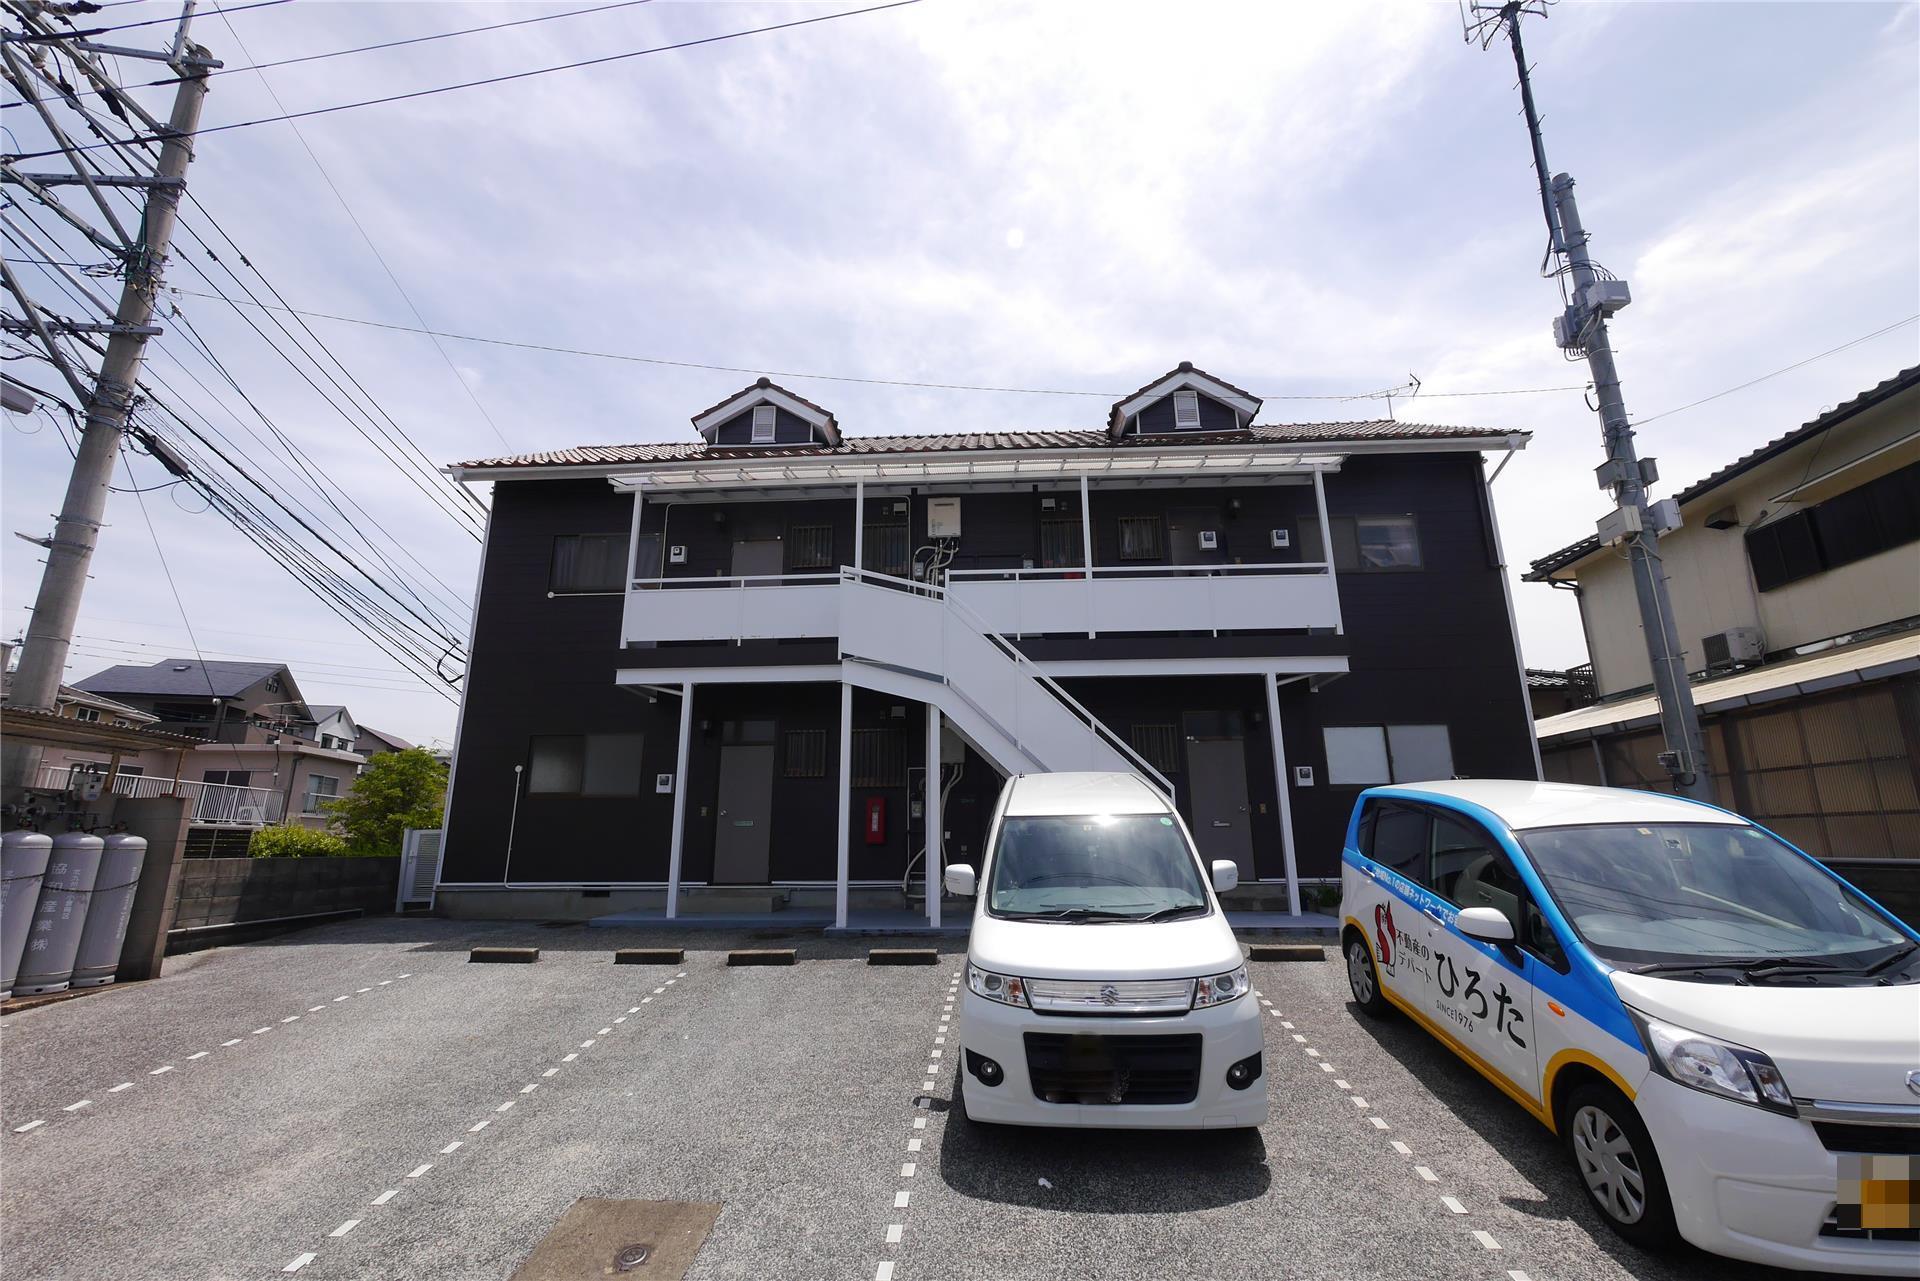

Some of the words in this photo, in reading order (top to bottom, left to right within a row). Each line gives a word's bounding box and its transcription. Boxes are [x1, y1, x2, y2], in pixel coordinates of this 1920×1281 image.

[1396, 928, 1430, 960] 不動産の
[1399, 950, 1432, 984] デパート
[1434, 951, 1526, 1049] ひろた
